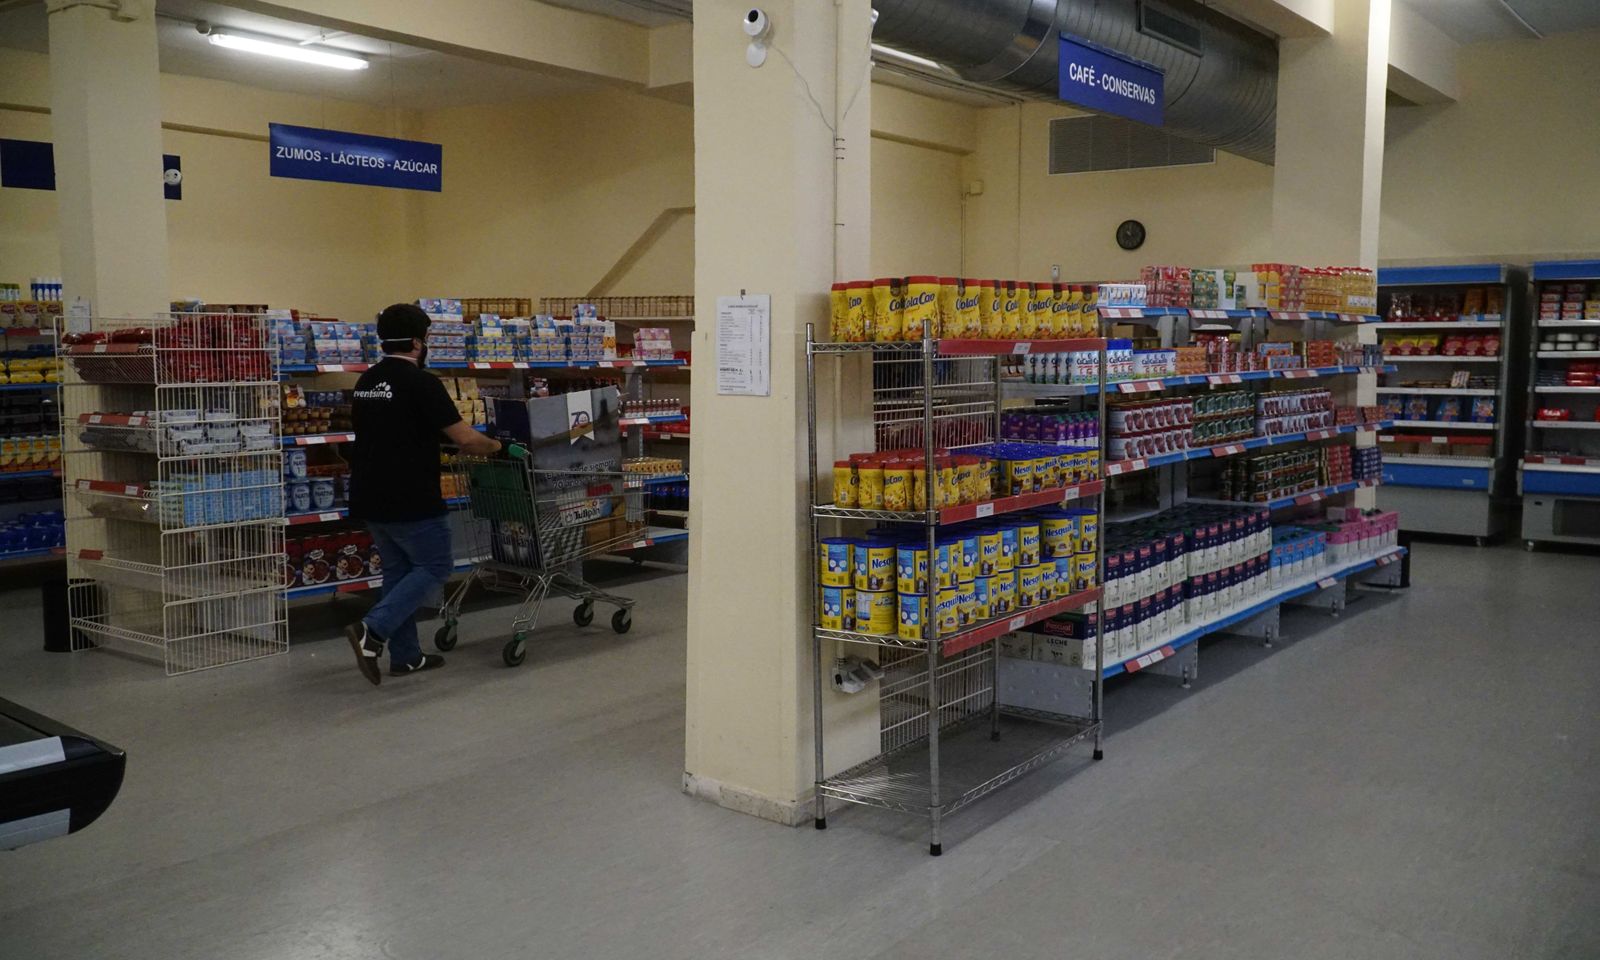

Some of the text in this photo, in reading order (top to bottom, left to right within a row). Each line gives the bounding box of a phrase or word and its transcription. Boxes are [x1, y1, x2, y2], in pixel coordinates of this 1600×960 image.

[1069, 63, 1095, 86] CAFÉ
[1102, 74, 1156, 105] CONSERVAS
[276, 146, 321, 162] ZUMOS
[331, 151, 385, 169] LÁCTEOS
[393, 159, 437, 174] AZÚCAR
[1047, 638, 1068, 646] LECHE
